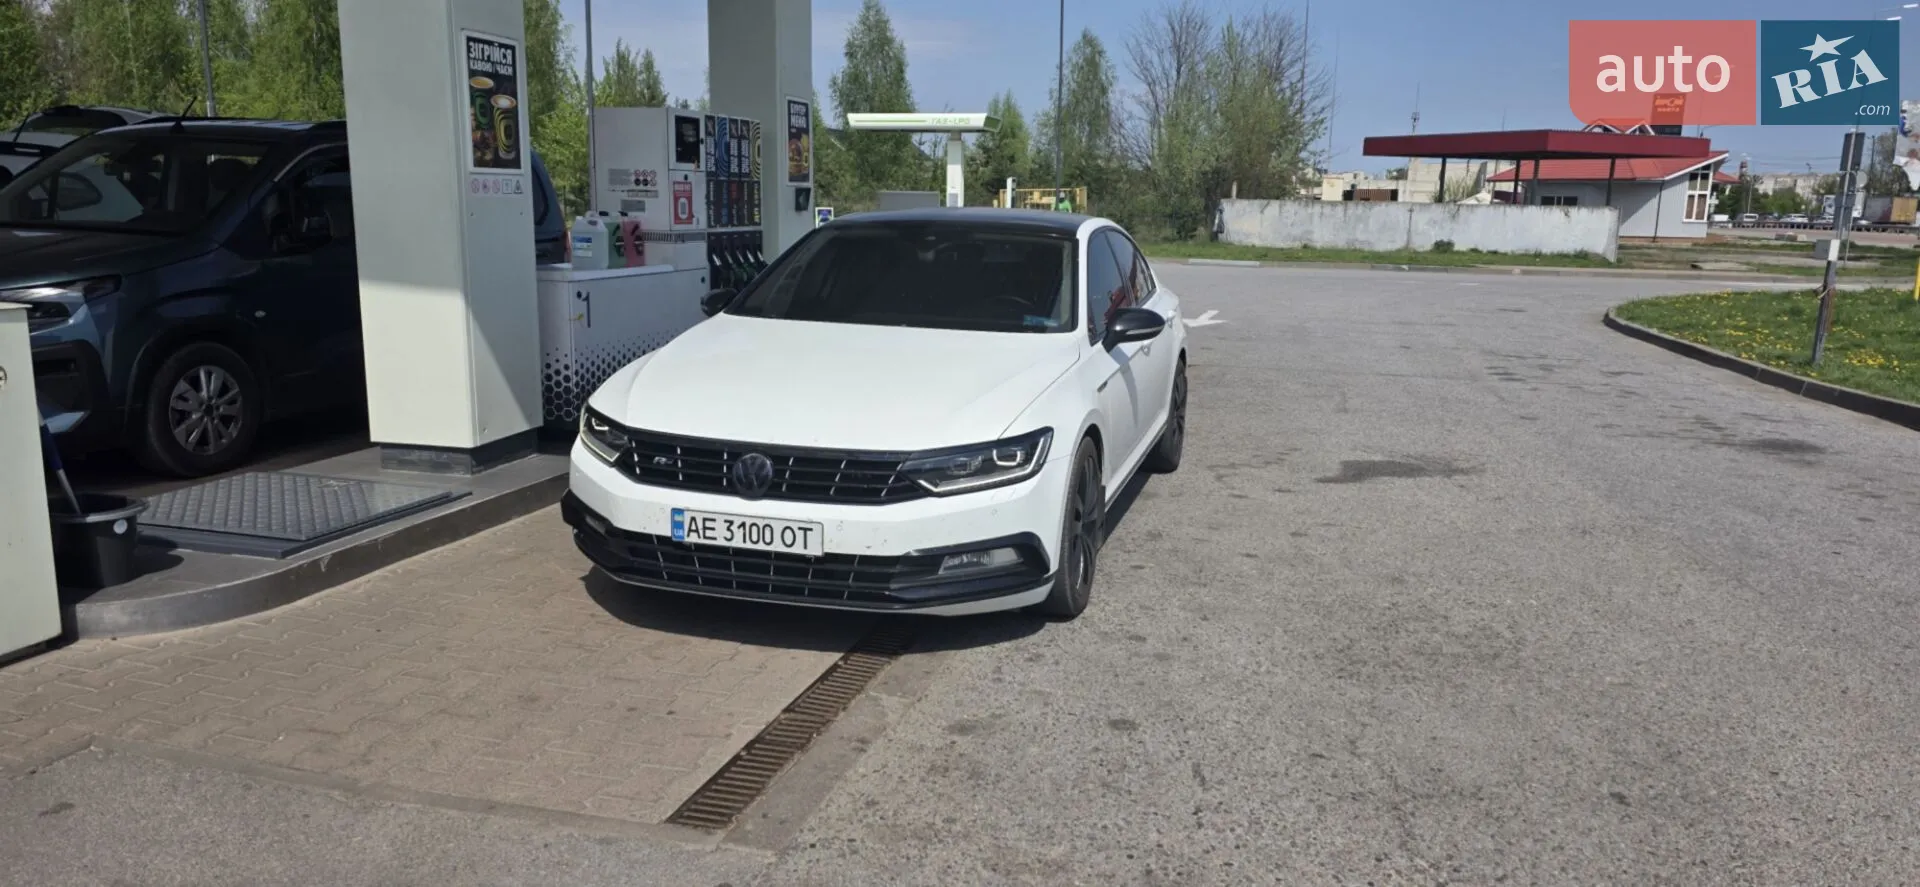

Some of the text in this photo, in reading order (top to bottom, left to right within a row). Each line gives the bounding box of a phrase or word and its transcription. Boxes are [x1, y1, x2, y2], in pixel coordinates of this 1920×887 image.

[469, 41, 513, 65] ЗІГРІЙСЯ
[470, 59, 493, 73] КАВОЮ
[686, 516, 813, 550] AE 3100 OT
